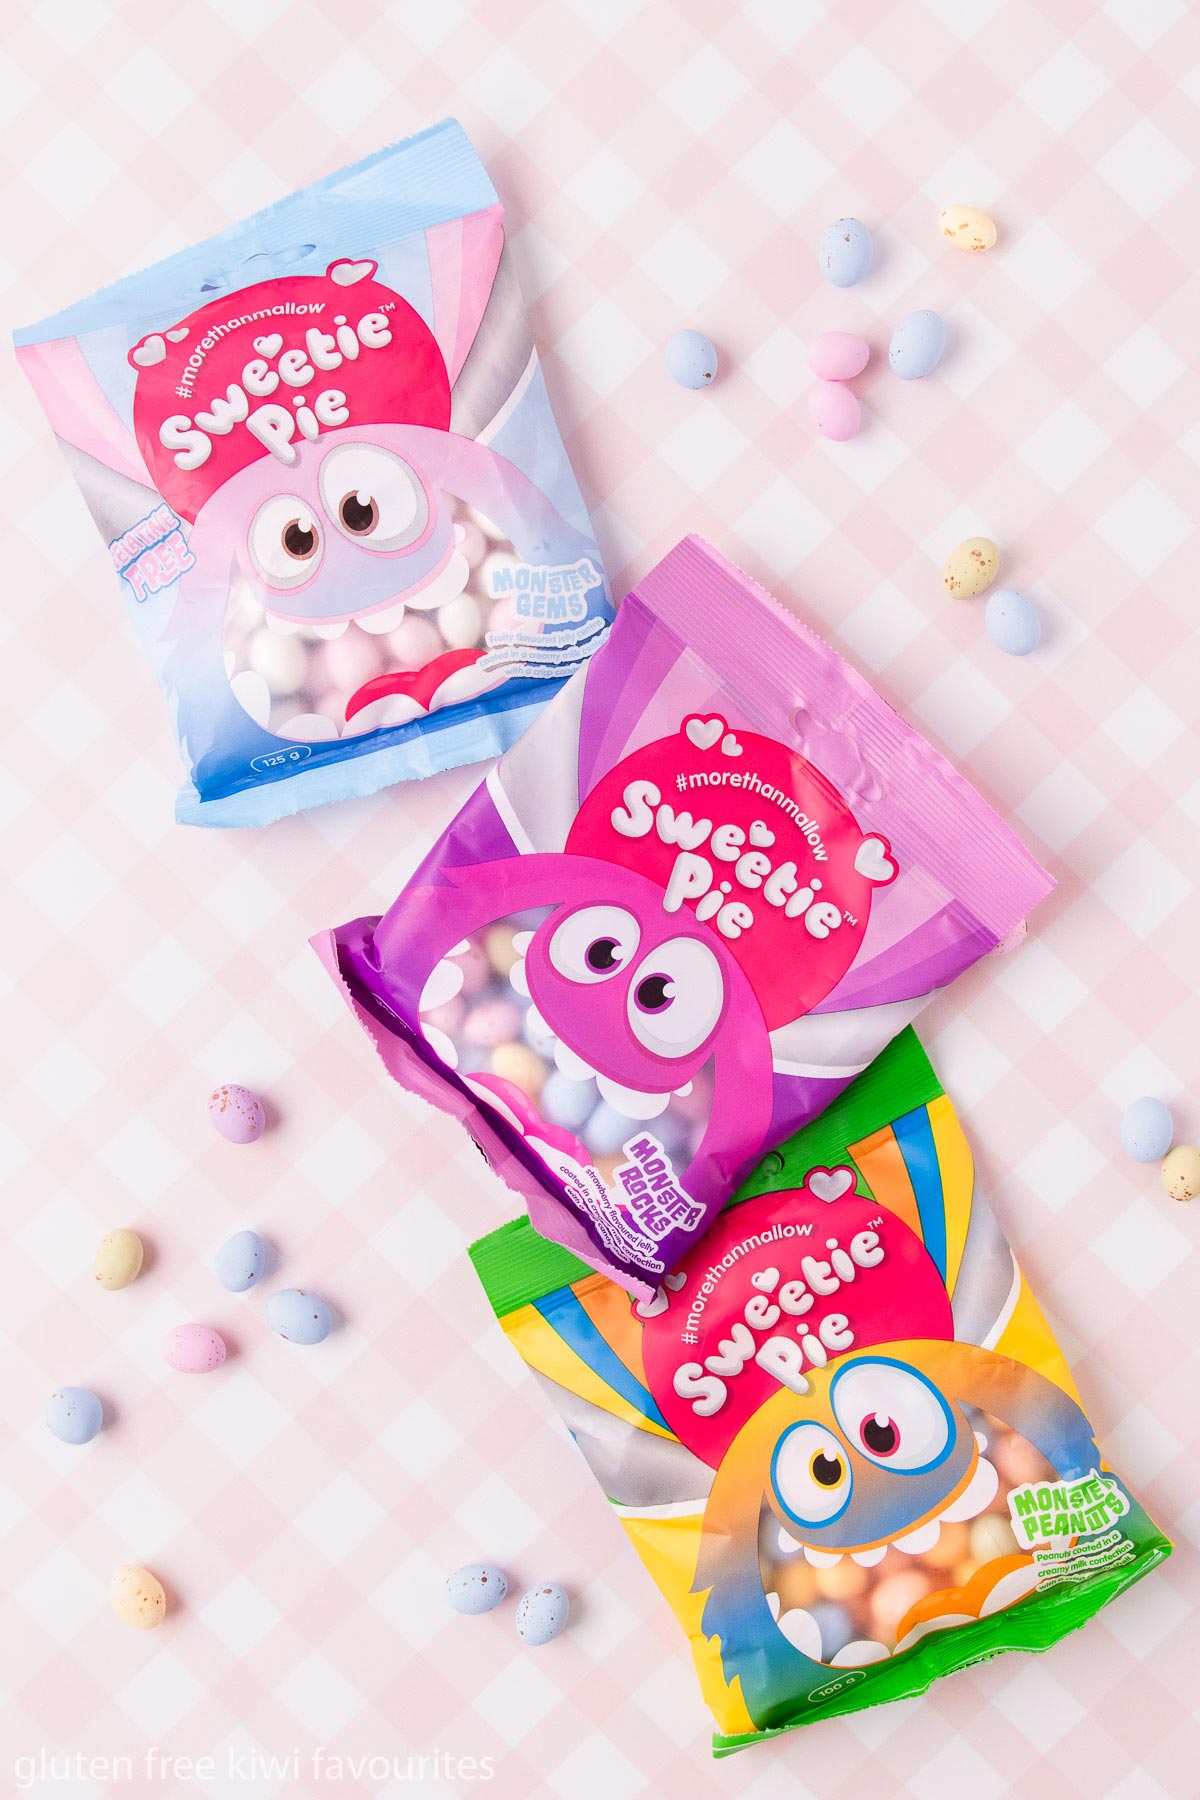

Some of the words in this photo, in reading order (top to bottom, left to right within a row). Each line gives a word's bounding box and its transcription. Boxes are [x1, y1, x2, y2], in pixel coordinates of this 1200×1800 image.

[175, 301, 326, 400] #morethanmallow
[159, 312, 393, 471] Sweetie
[246, 389, 350, 465] Pie
[123, 532, 194, 599] FREE
[492, 563, 597, 594] MONSTER
[515, 633, 560, 645] flavoured
[559, 631, 575, 645] jelly
[516, 593, 583, 619] GEMS
[479, 650, 508, 667] coated
[510, 650, 519, 659] in
[562, 647, 581, 658] milk
[582, 630, 610, 655] confec
[504, 667, 524, 676] with
[535, 667, 554, 677] crisp
[555, 665, 578, 676] cand
[262, 755, 285, 767] 125
[289, 751, 300, 761] g
[675, 771, 829, 862] #morethanmallow
[611, 780, 842, 939] Sweetie
[662, 851, 754, 939] Pie
[559, 1166, 586, 1189] coated
[582, 1188, 590, 1197] in
[621, 1245, 662, 1270] confection
[567, 1188, 580, 1204] with
[585, 1168, 612, 1210] strawberry
[609, 1210, 639, 1243] flavoured
[636, 1238, 655, 1254] jelly
[619, 1165, 672, 1236] ROCKS
[629, 1138, 702, 1227] MONSTER
[681, 1223, 814, 1345] #morethanmallow
[673, 1230, 885, 1417] Sweetie
[755, 1313, 855, 1395] Pie
[1022, 1492, 1125, 1542] PEANUTS
[1037, 1550, 1071, 1562] Peanuts
[1072, 1542, 1103, 1555] coated
[1102, 1537, 1112, 1546] in
[1037, 1564, 1070, 1577] creamy
[1070, 1559, 1088, 1571] milk
[1089, 1543, 1132, 1566] confection
[818, 1683, 843, 1697] 100
